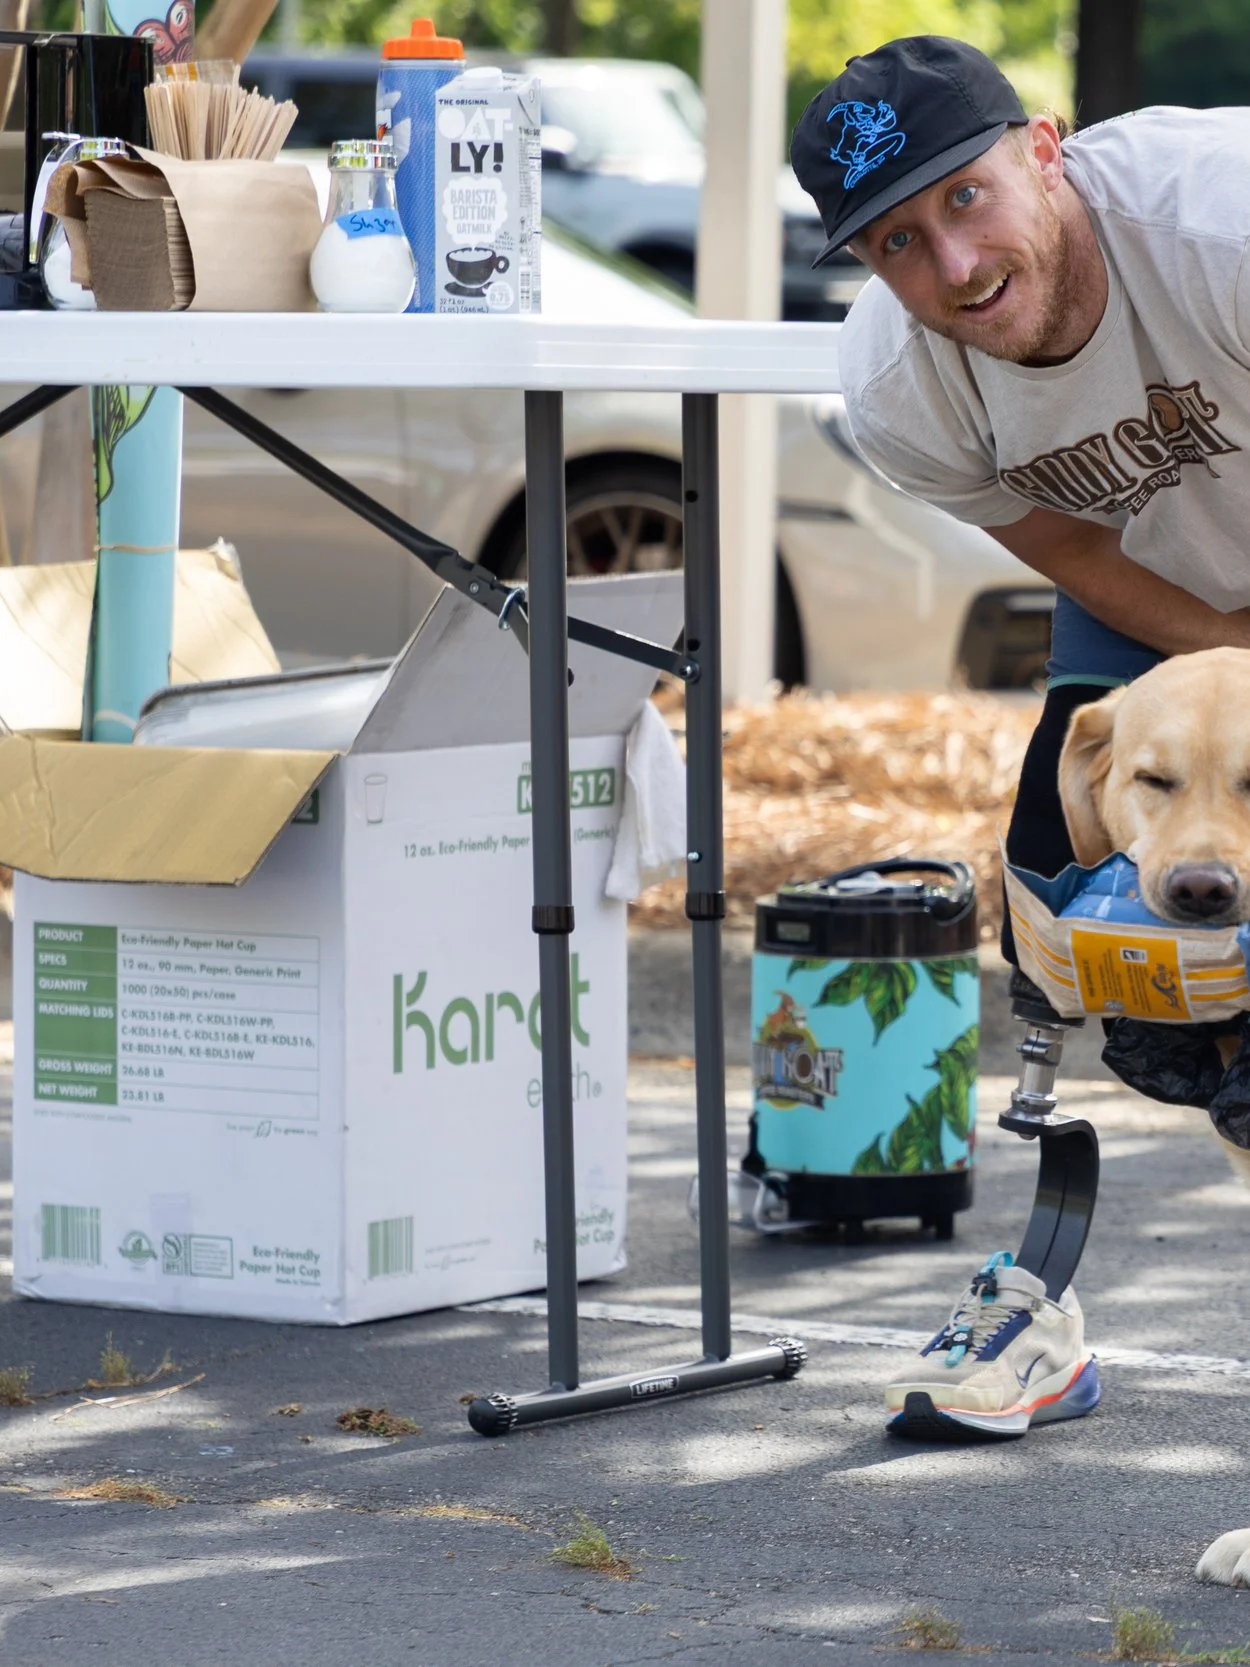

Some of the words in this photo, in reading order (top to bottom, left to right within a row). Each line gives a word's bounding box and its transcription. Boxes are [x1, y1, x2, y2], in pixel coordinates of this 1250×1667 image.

[450, 141, 504, 174] LY!
[450, 189, 498, 205] BARISTA
[452, 205, 496, 220] EDITION
[456, 223, 492, 234] OATMILK
[404, 843, 417, 858] 12
[439, 835, 499, 855] Eco-Friendly
[502, 834, 530, 852] Paper
[39, 928, 83, 942] PRODUCT
[122, 933, 180, 951] Eco-Friendly
[183, 936, 213, 952] Paper
[215, 938, 234, 950] Hot
[236, 939, 257, 954] Cup
[39, 952, 67, 966] SPECS
[122, 957, 135, 970] 12
[158, 960, 172, 972] 90
[234, 965, 273, 977] Generic
[277, 967, 302, 979] Print
[38, 977, 88, 992] QUANTITY
[122, 983, 147, 995] 1000
[39, 1002, 91, 1018] MATCHING
[93, 1006, 114, 1019] LIDS
[38, 1058, 72, 1073] GROSS
[73, 1061, 113, 1075] WEIGHT
[38, 1083, 57, 1096] NET
[58, 1085, 99, 1098] WEIGHT
[252, 1244, 321, 1265] Eco-Friendly
[239, 1260, 272, 1277] Paper
[276, 1262, 296, 1275] Hot
[299, 1264, 321, 1281] Cup
[636, 1378, 675, 1395] LIFETIME
